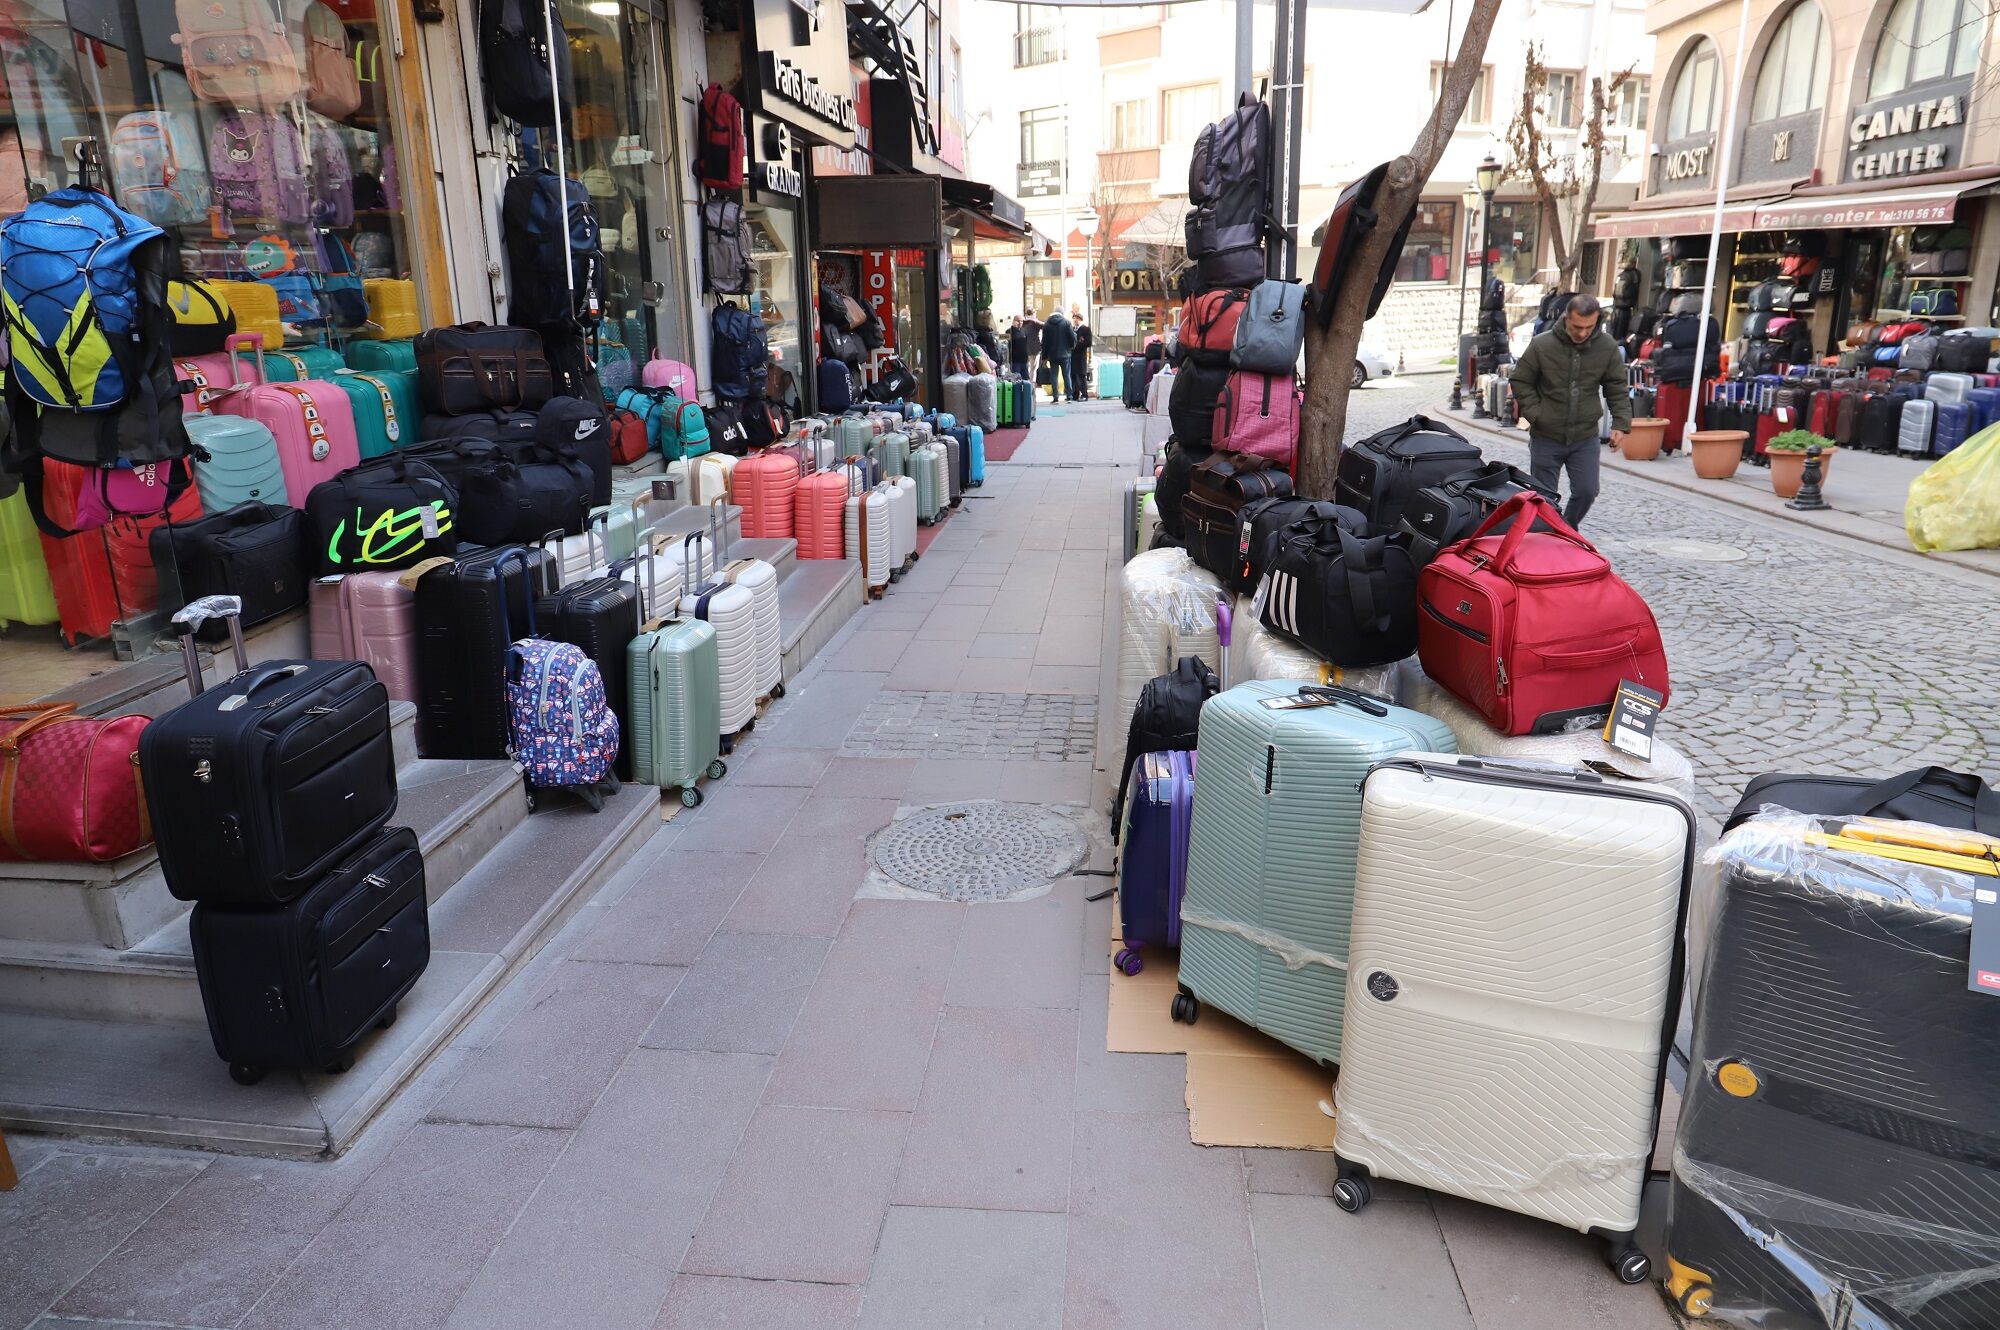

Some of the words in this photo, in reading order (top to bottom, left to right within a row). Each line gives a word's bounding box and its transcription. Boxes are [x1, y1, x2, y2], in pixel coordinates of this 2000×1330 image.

[773, 50, 801, 103] Paris
[801, 69, 840, 124] Business
[840, 94, 857, 132] Club
[1850, 95, 1956, 151] ÇANTA
[1665, 146, 1708, 181] MOST
[1852, 143, 1945, 180] CENTER
[767, 162, 801, 198] GRANDE
[1812, 209, 1874, 224] center
[1916, 207, 1929, 219] 56
[1932, 206, 1946, 218] 76
[578, 418, 597, 431] NIKE
[1623, 698, 1654, 716] CCS
